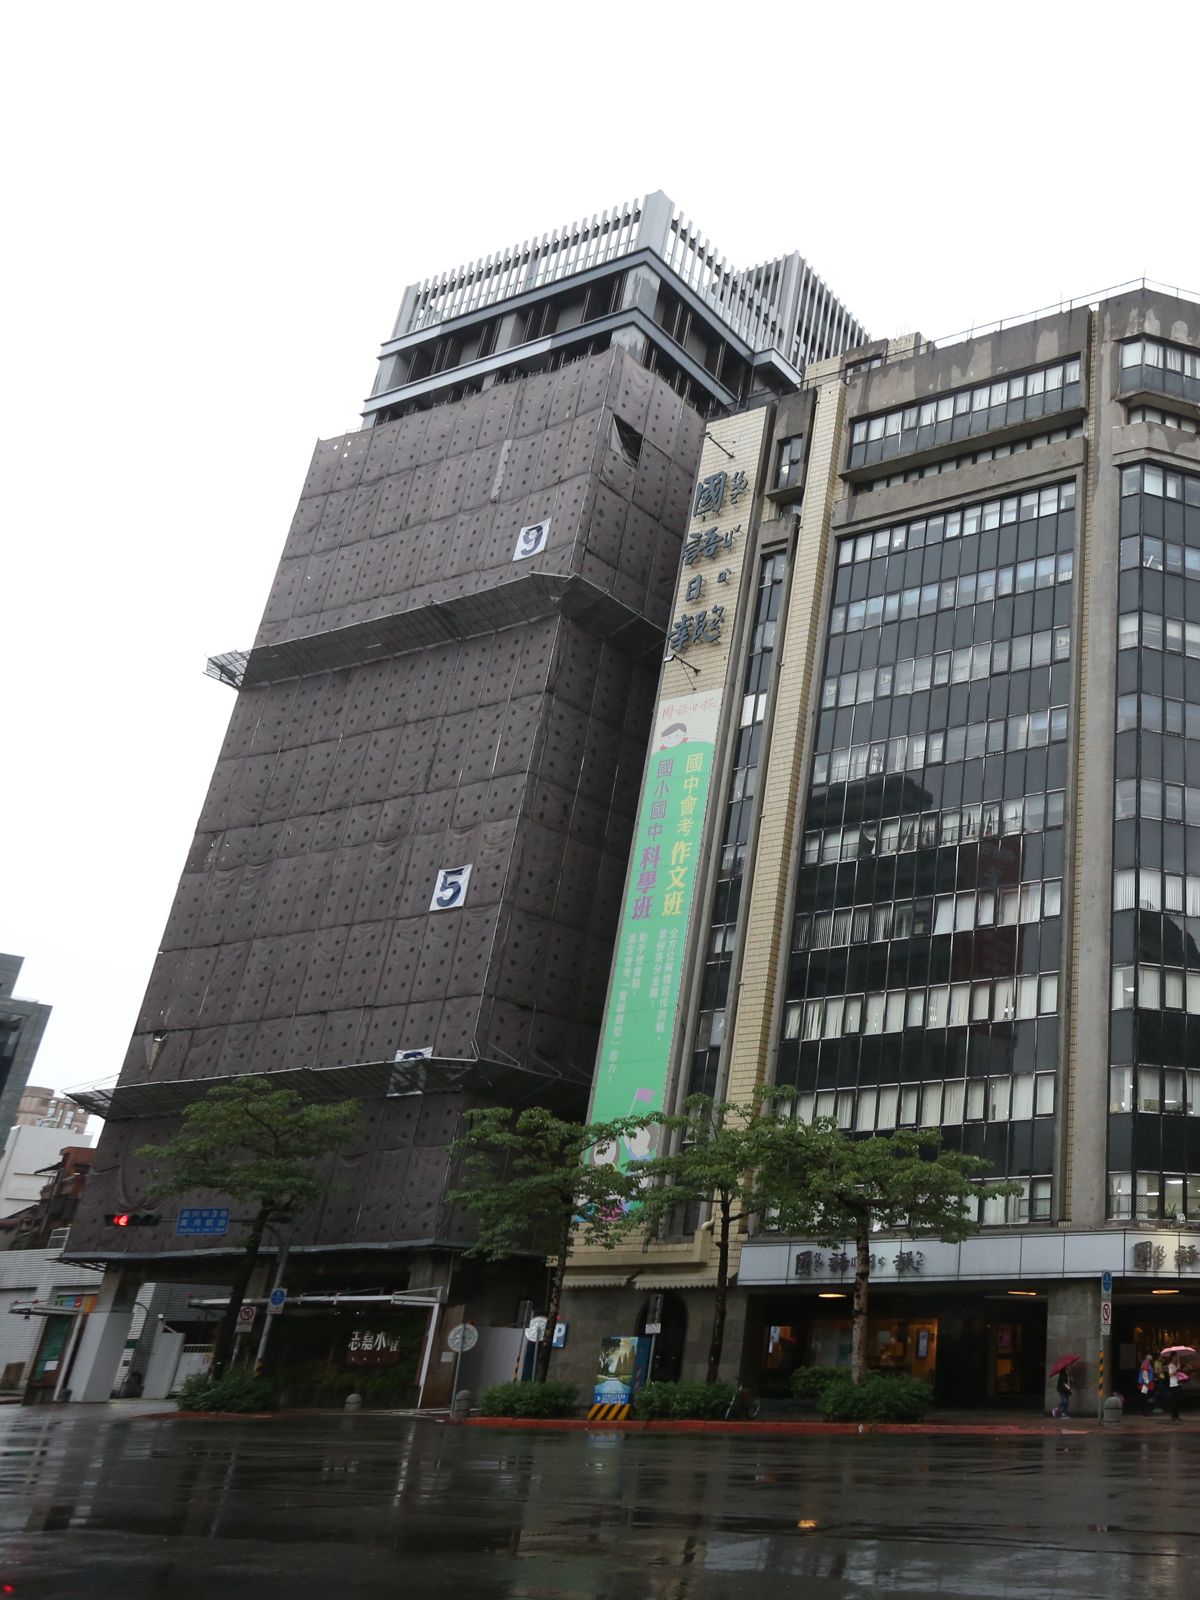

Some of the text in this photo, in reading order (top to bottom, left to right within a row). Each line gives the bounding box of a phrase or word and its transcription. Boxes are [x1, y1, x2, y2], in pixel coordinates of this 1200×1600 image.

[520, 525, 543, 556] 9
[436, 867, 465, 908] 5
[552, 1322, 566, 1344] P
